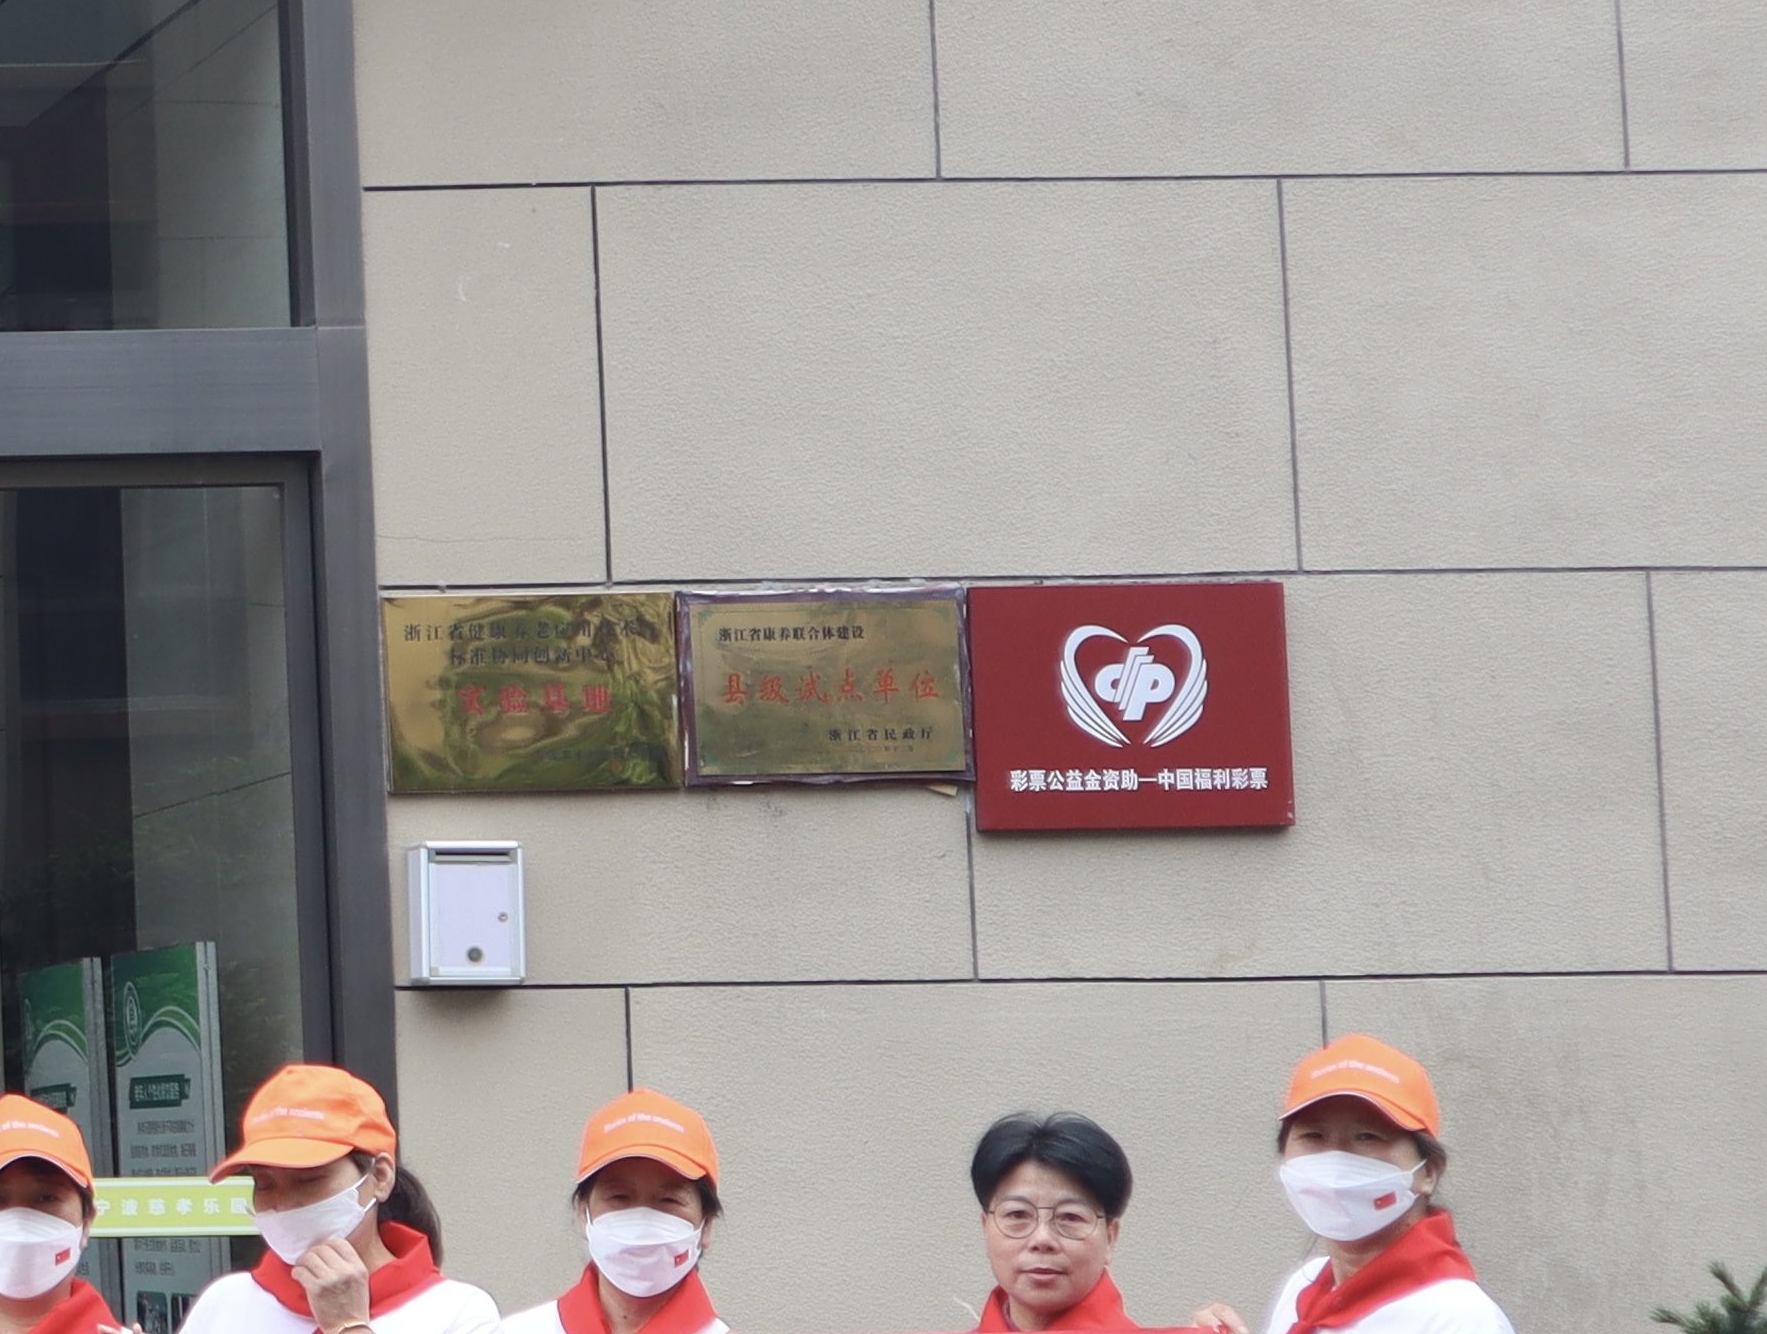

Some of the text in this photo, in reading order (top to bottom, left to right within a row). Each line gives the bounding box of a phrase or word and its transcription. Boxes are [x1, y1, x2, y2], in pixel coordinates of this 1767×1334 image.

[719, 625, 865, 643] 浙江省康养联合体建设
[457, 683, 613, 715] 实验基地
[722, 667, 941, 706] 县级试点单位
[828, 727, 934, 742] 浙江省民政厅
